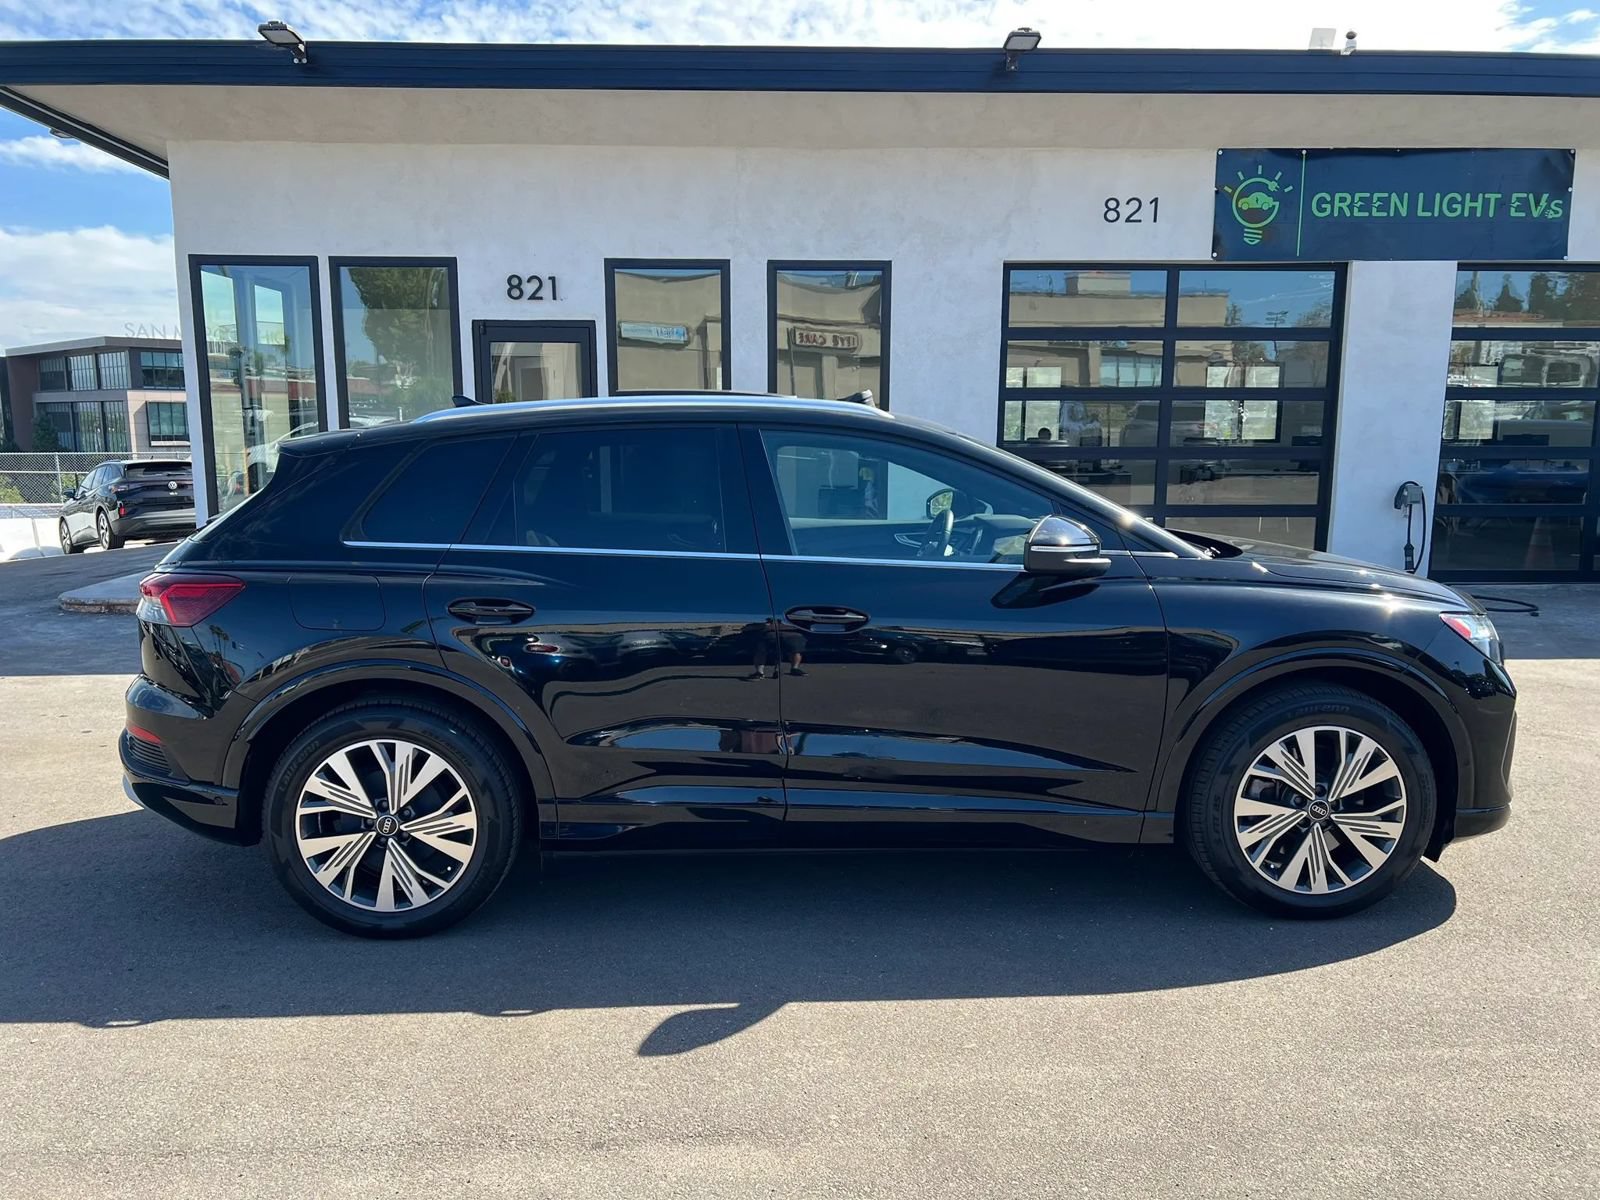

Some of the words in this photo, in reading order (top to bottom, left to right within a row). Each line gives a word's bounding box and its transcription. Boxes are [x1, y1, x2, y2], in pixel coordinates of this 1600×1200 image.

[1103, 197, 1159, 223] 821
[1311, 192, 1409, 217] GREEN
[1417, 192, 1502, 218] LIGHT
[506, 274, 557, 301] 821
[124, 322, 166, 339] SAN
